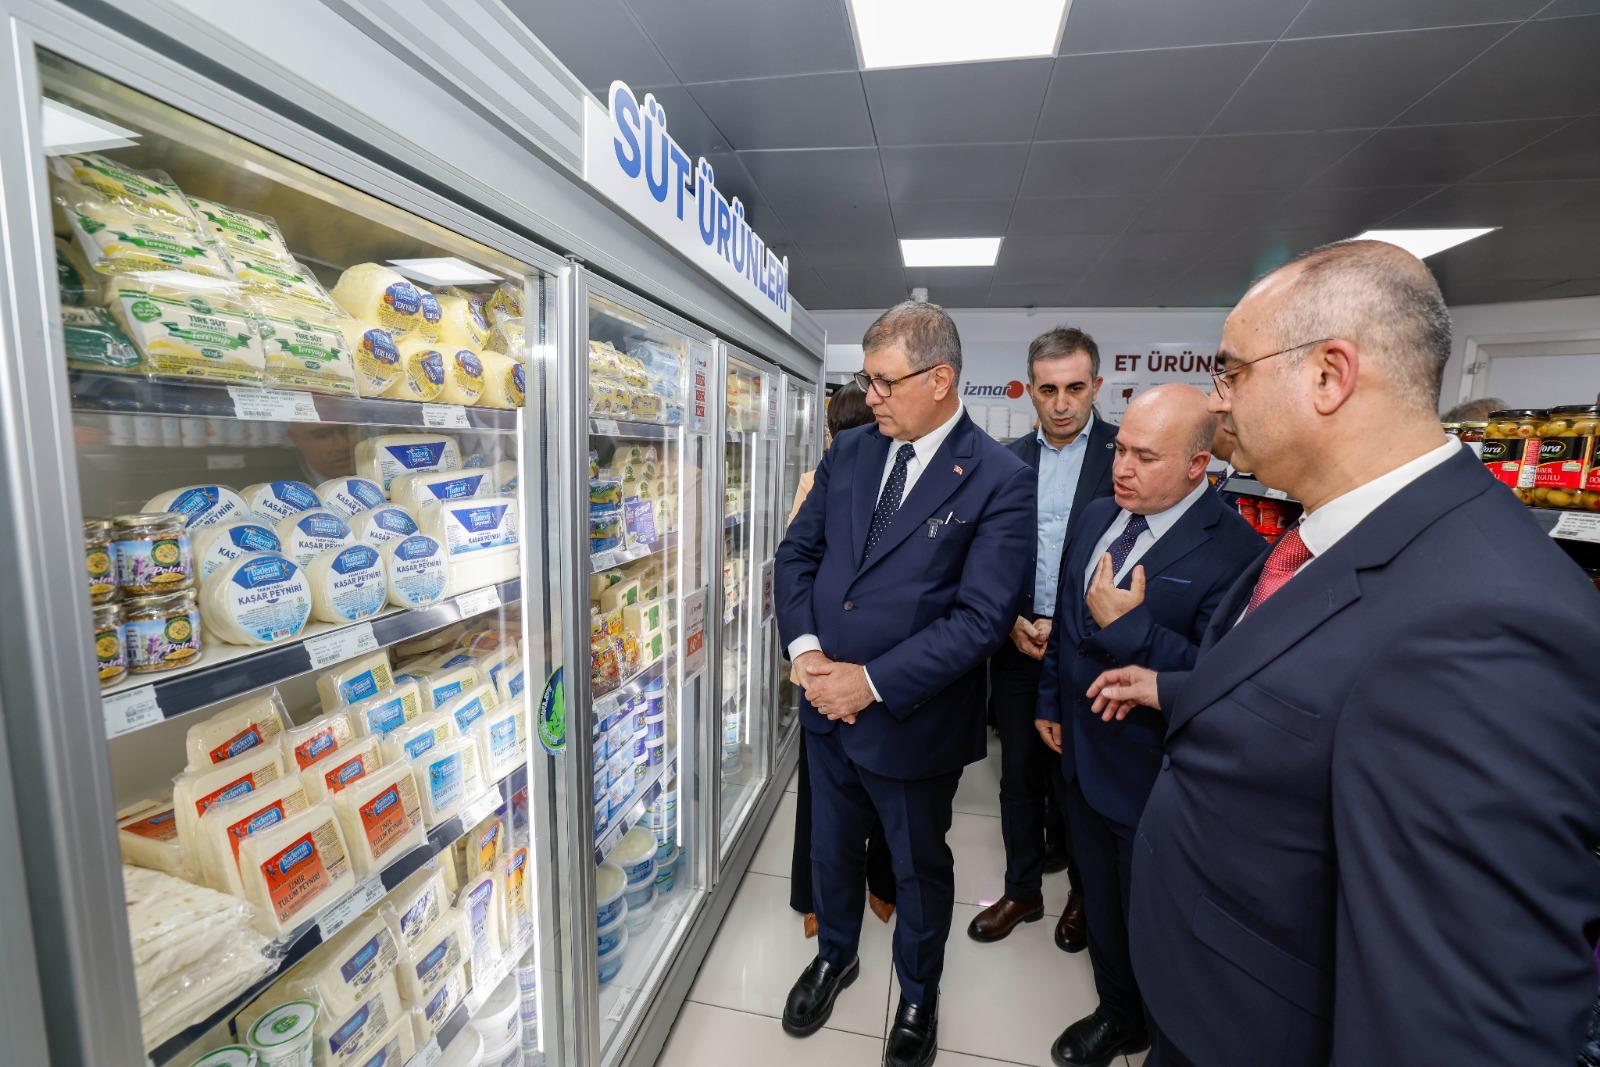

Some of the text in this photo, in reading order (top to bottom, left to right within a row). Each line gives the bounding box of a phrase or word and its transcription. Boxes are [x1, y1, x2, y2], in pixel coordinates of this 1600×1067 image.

[613, 87, 788, 313] SÜT ÜRÜNLERİ
[1114, 354, 1142, 372] ET
[963, 380, 1011, 396] izmar
[152, 564, 185, 577] Polen
[237, 582, 303, 606] KAŞAR PEYNİRİ
